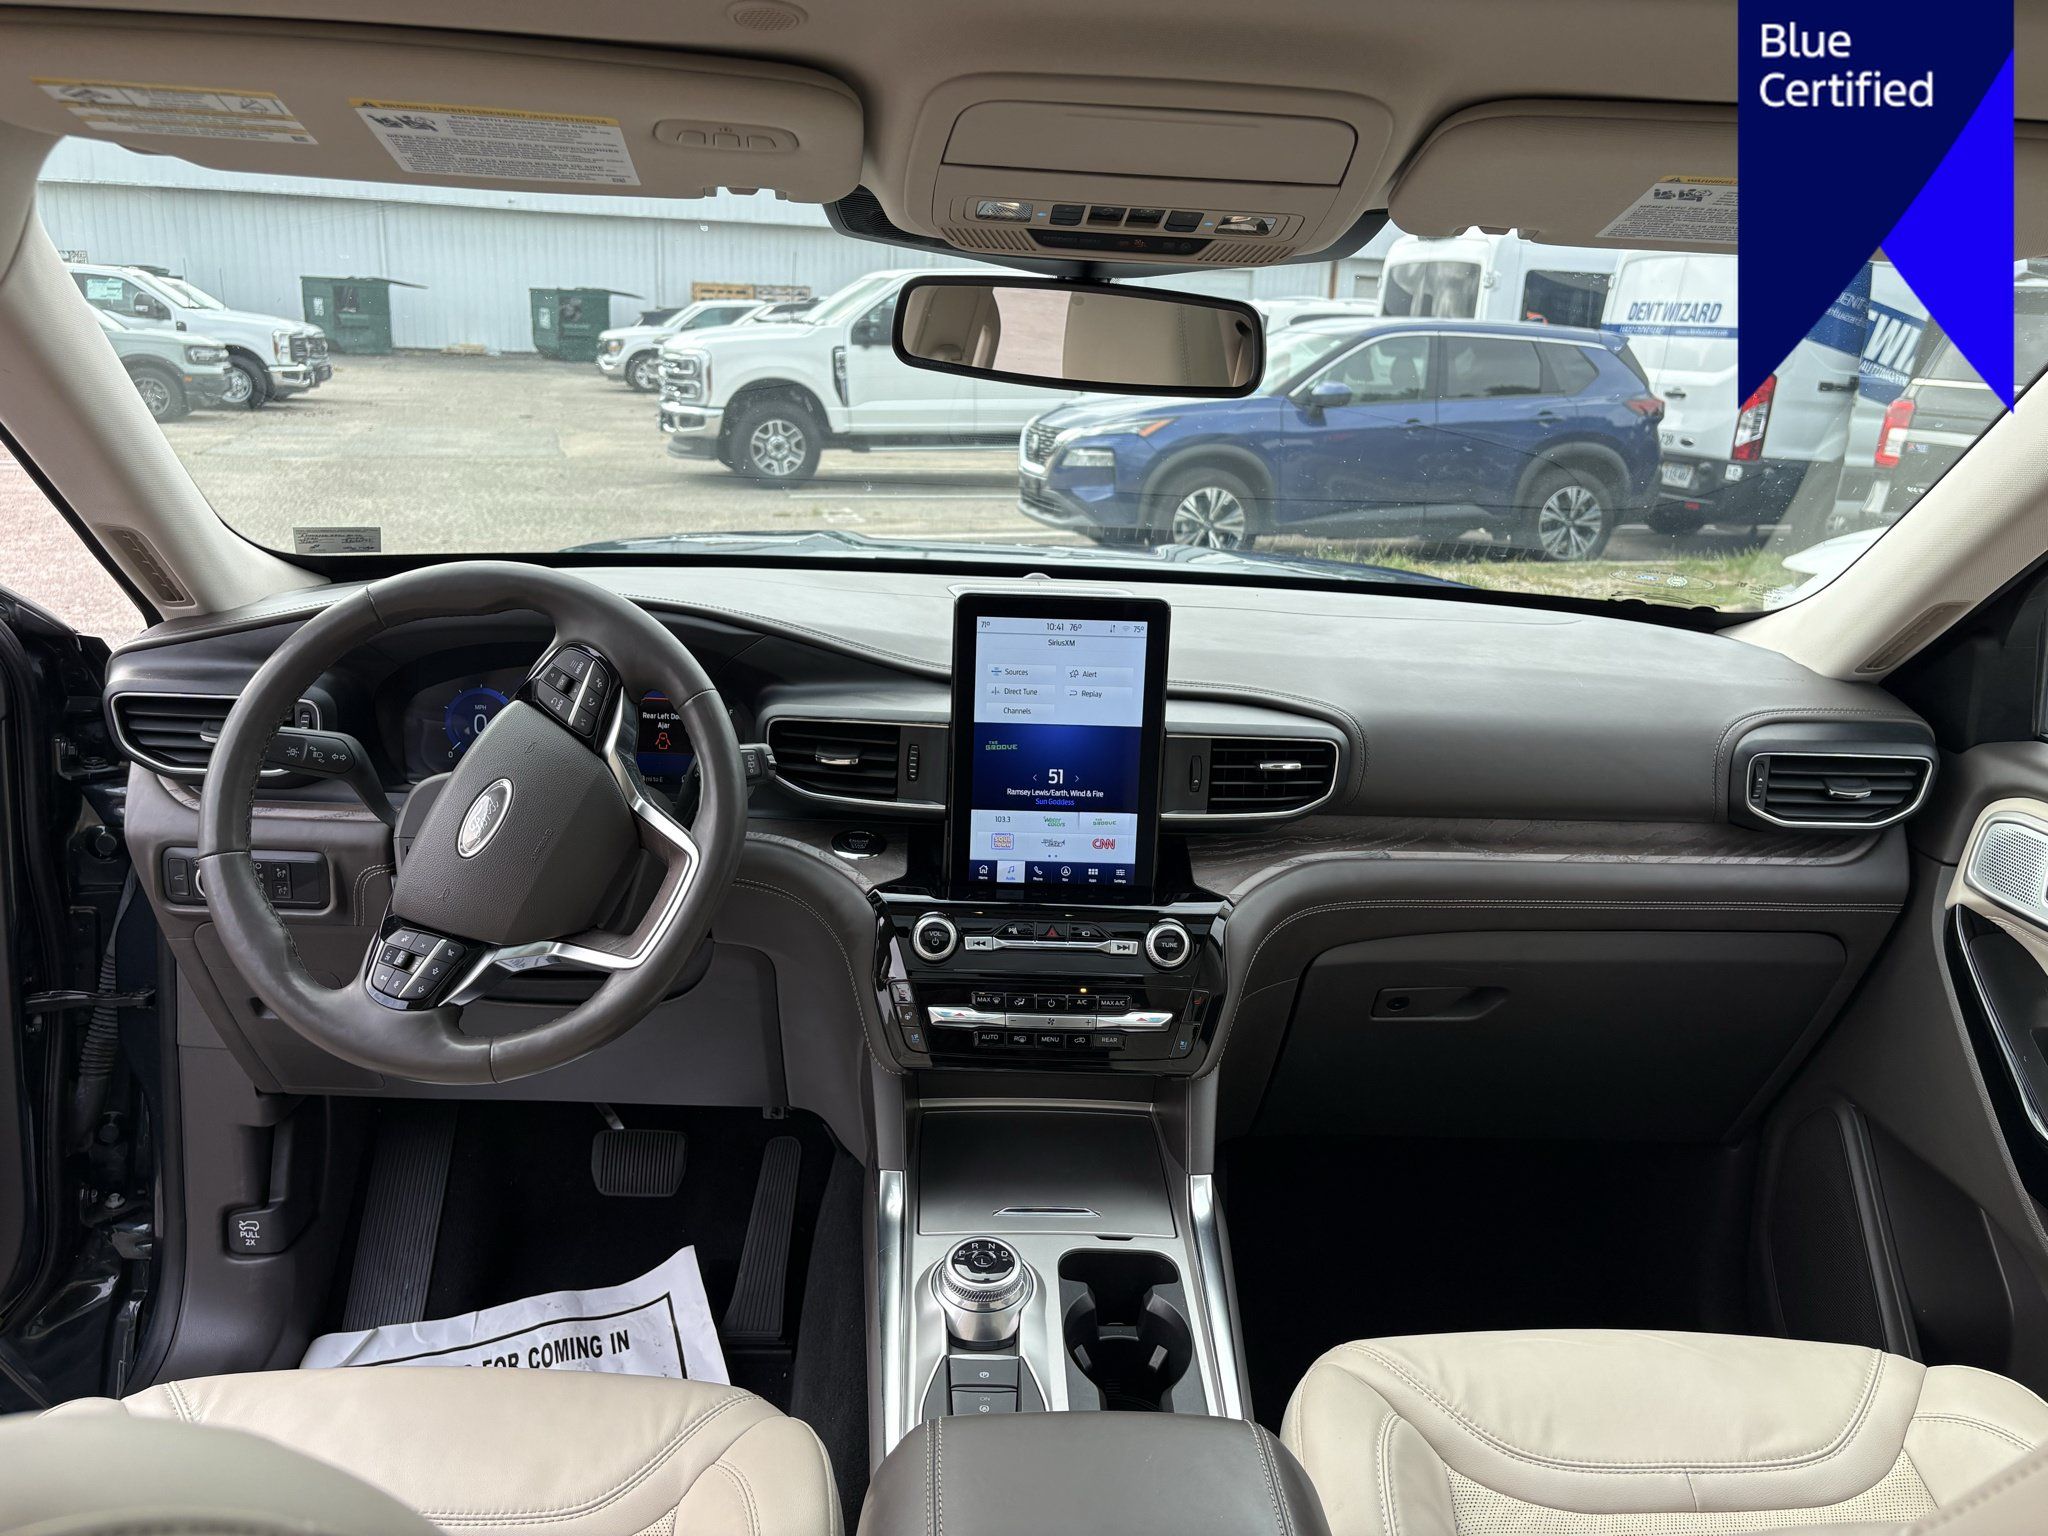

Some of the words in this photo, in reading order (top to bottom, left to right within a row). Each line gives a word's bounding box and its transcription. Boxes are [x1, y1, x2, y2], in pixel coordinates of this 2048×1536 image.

[1628, 302, 1663, 322] DENT
[1662, 302, 1722, 324] WIZARD
[1046, 623, 1064, 631] 10:41
[1048, 639, 1075, 647] SiriusXM
[1004, 668, 1028, 676] Sources
[1081, 690, 1102, 699] Replay
[1003, 707, 1032, 715] Channels
[474, 714, 487, 734] 0
[1048, 769, 1064, 784] 51
[1007, 788, 1031, 797] Ramsey
[1032, 789, 1069, 798] Lewis/Earth,
[1092, 838, 1116, 850] CNN
[240, 1230, 260, 1239] PULL
[529, 1335, 602, 1368] COMING
[610, 1330, 630, 1354] IN
